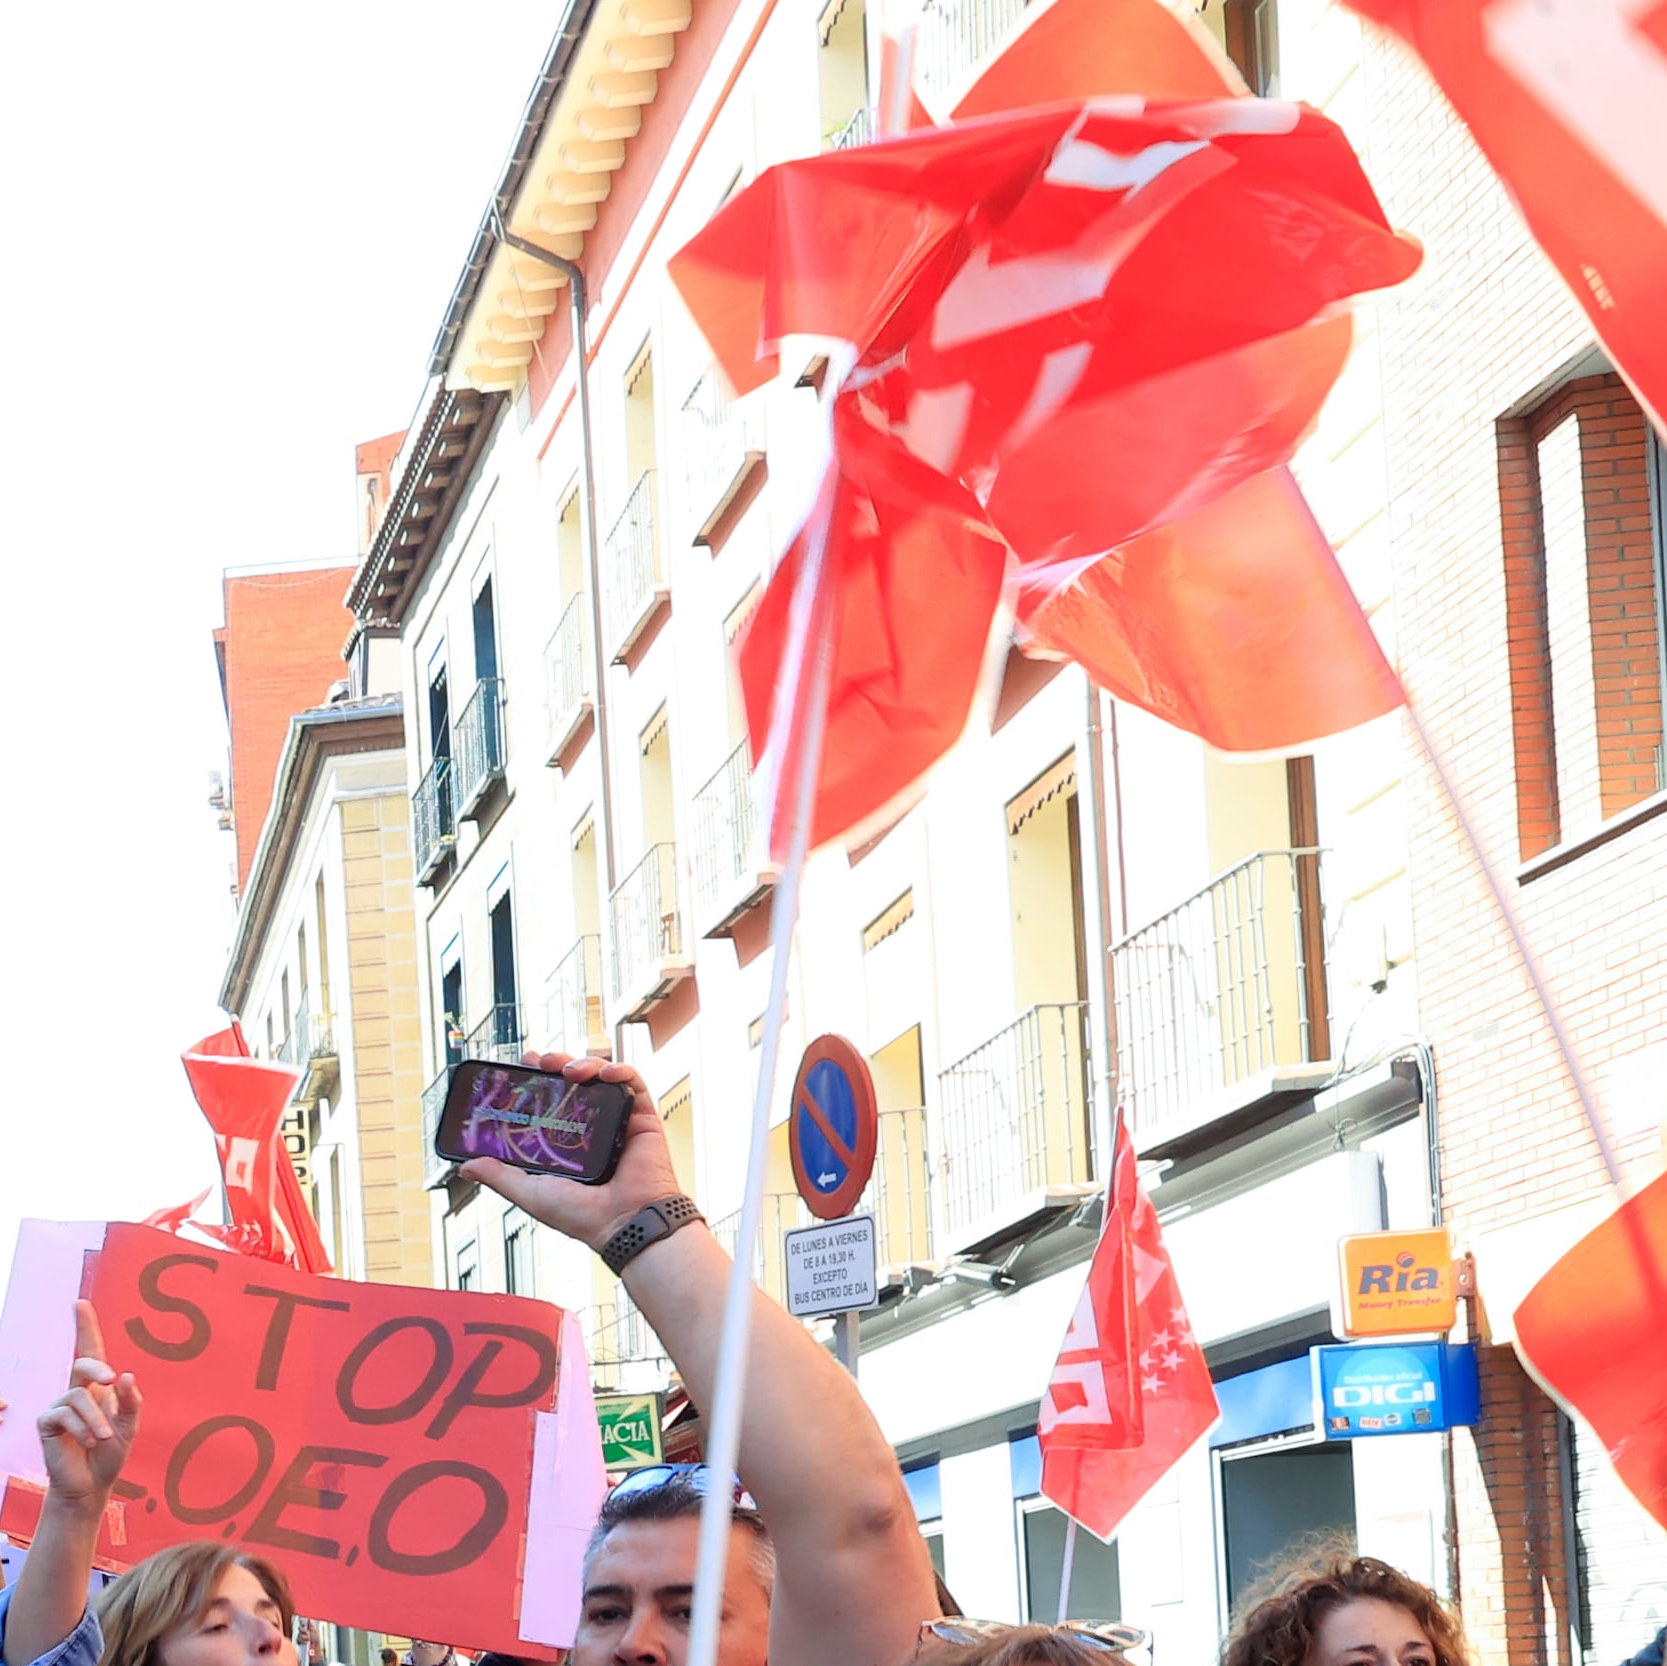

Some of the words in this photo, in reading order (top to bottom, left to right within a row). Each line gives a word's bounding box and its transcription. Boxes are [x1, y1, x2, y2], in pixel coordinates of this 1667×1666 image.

[790, 1242, 801, 1255] DE
[802, 1236, 827, 1253] LUNES
[828, 1236, 835, 1247] A
[835, 1229, 869, 1247] VIERNES
[803, 1257, 814, 1270] DE
[821, 1255, 827, 1266] A
[1357, 1250, 1440, 1295] Ria
[812, 1268, 848, 1285] EXCEPTO
[794, 1290, 810, 1305] BUS
[810, 1286, 842, 1303] CENTRO
[843, 1284, 854, 1297] DE
[854, 1279, 869, 1295] DÍA
[123, 1253, 560, 1440] STOP
[1332, 1381, 1437, 1408] DIGI
